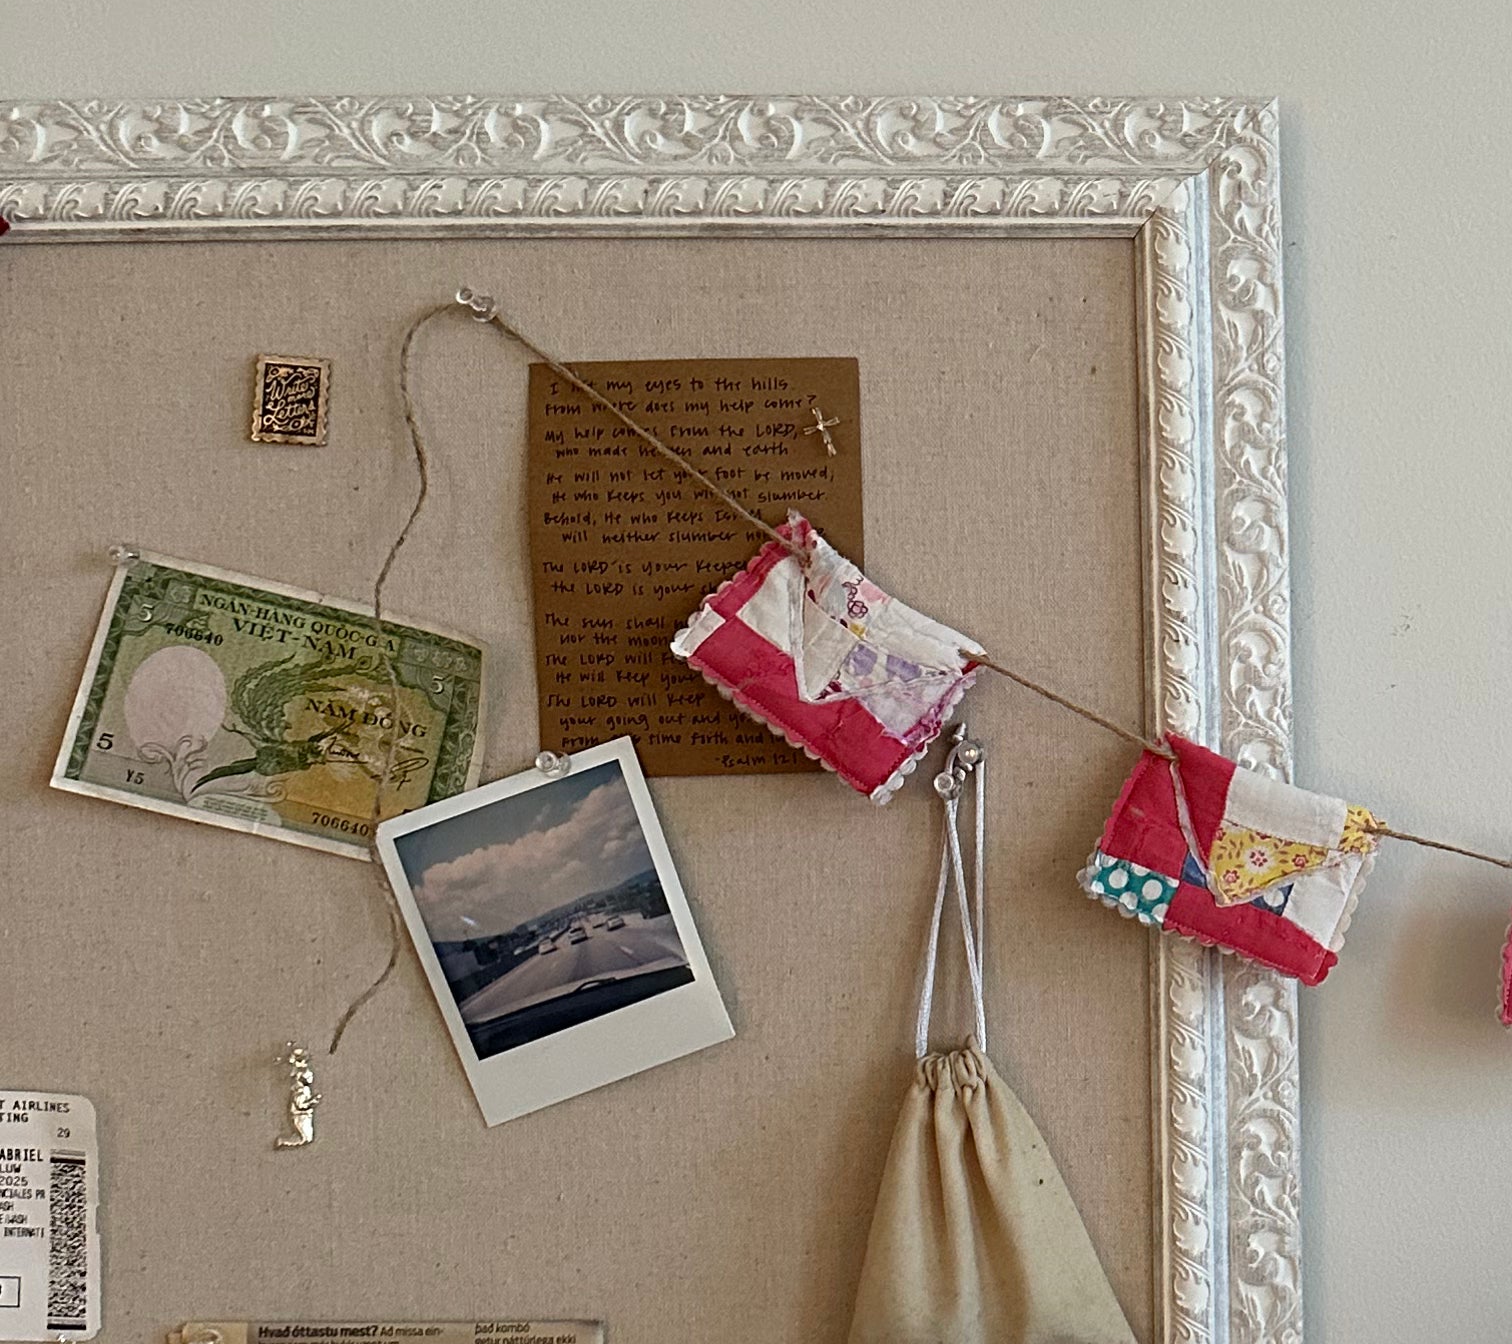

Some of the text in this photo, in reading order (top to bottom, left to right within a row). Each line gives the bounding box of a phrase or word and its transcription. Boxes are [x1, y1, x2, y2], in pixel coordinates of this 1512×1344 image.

[265, 373, 315, 400] Write
[551, 377, 741, 395] I my eyes to the
[645, 401, 674, 413] does
[685, 400, 709, 416] my
[720, 400, 754, 413] help
[575, 426, 604, 440] help
[719, 425, 744, 437] the
[556, 442, 788, 458] who made and earth
[546, 473, 562, 484] He
[574, 470, 599, 482] will
[609, 469, 632, 482] not
[643, 468, 666, 481] let
[754, 470, 770, 481] be
[552, 489, 682, 505] He who you
[604, 512, 621, 524] He
[630, 512, 658, 524] who
[562, 531, 588, 544] will
[602, 531, 659, 544] neither
[668, 531, 736, 544] slumber
[543, 560, 688, 576] The LORD is your
[552, 581, 575, 593] the
[586, 583, 624, 595] LORD
[633, 583, 643, 595] is
[654, 584, 695, 600] your
[137, 604, 154, 622] 5
[545, 613, 569, 626] The
[582, 616, 613, 628] sun
[626, 616, 664, 629] shall
[310, 620, 396, 653] QUỐC-GA
[560, 633, 668, 646] nor the moon
[545, 654, 568, 666] The
[580, 655, 615, 666] LORD
[625, 654, 652, 666] will
[556, 670, 570, 683] He
[580, 670, 605, 683] will
[431, 675, 447, 695] 5
[548, 694, 656, 708] The LORD will
[560, 717, 596, 731] your
[607, 713, 649, 731] going
[658, 714, 685, 725] out
[692, 712, 720, 725] and
[96, 733, 114, 750] 5
[649, 732, 682, 745] time
[735, 732, 764, 745] and
[311, 812, 369, 837] 706640
[13, 1100, 70, 1113] AIRLINES
[57, 1127, 71, 1138] 29
[0, 1148, 44, 1162] ABRIEL
[0, 1176, 28, 1187] 2025
[259, 1327, 290, 1338] Hvað
[340, 1325, 379, 1336] mest?
